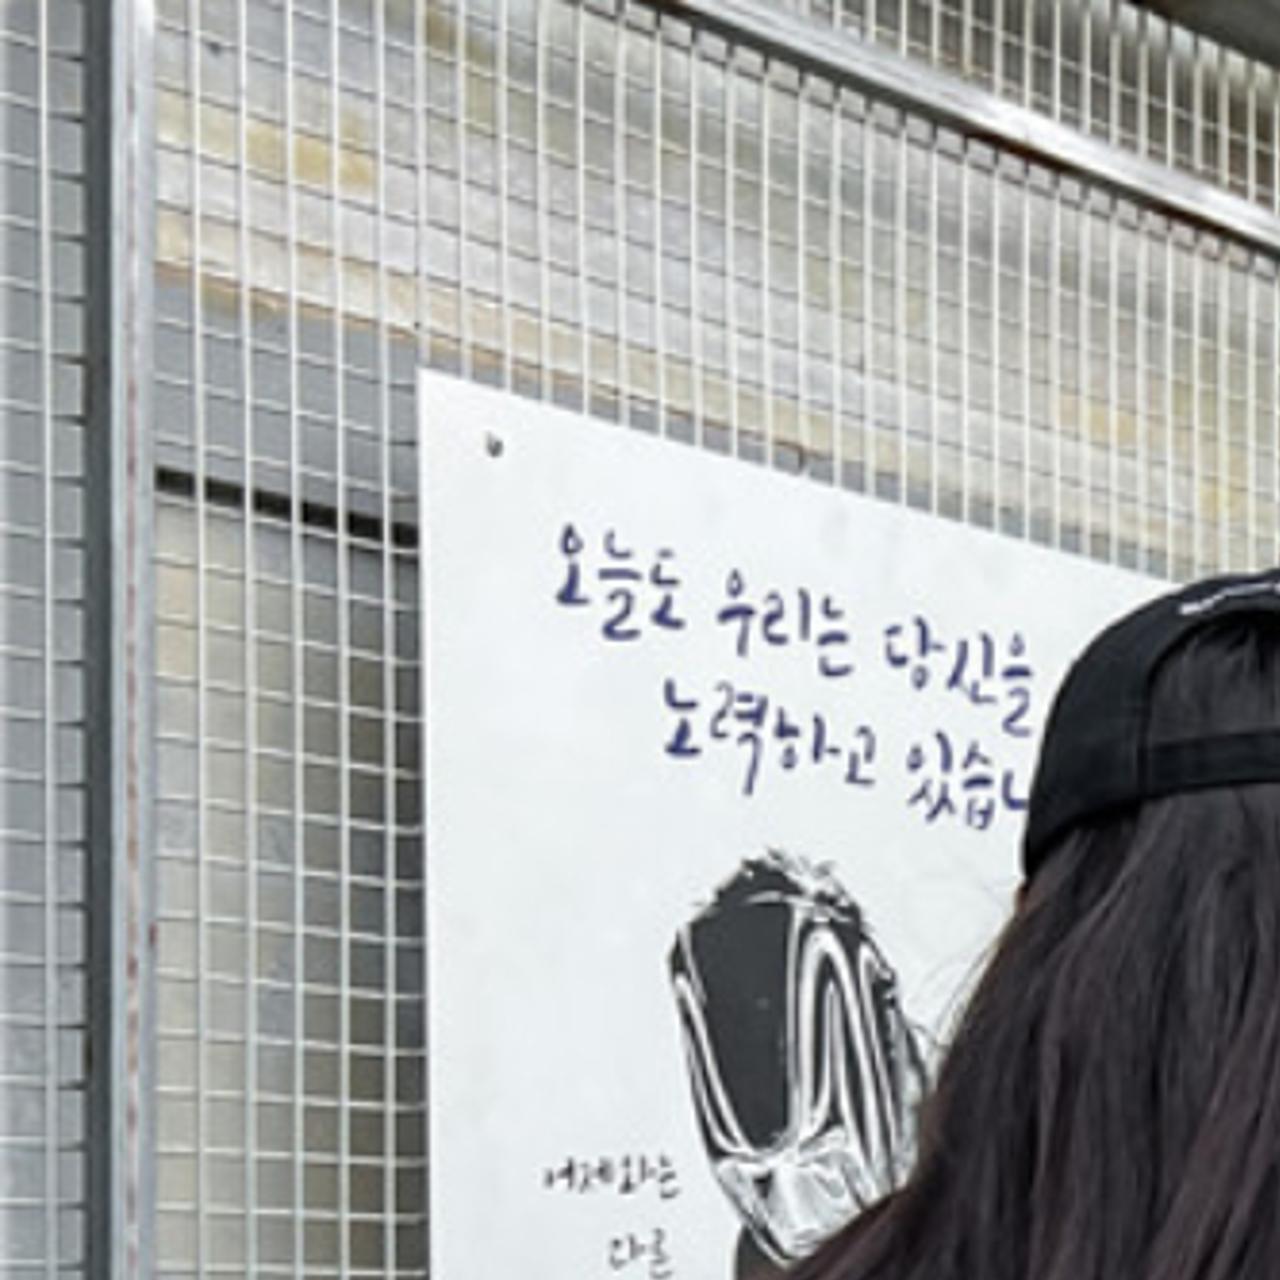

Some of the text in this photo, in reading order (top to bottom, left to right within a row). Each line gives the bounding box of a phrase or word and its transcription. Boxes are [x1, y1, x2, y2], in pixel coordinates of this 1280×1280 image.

[555, 523, 1034, 738] 오늘도 우리는 당신을
[663, 678, 876, 797] 노력하고
